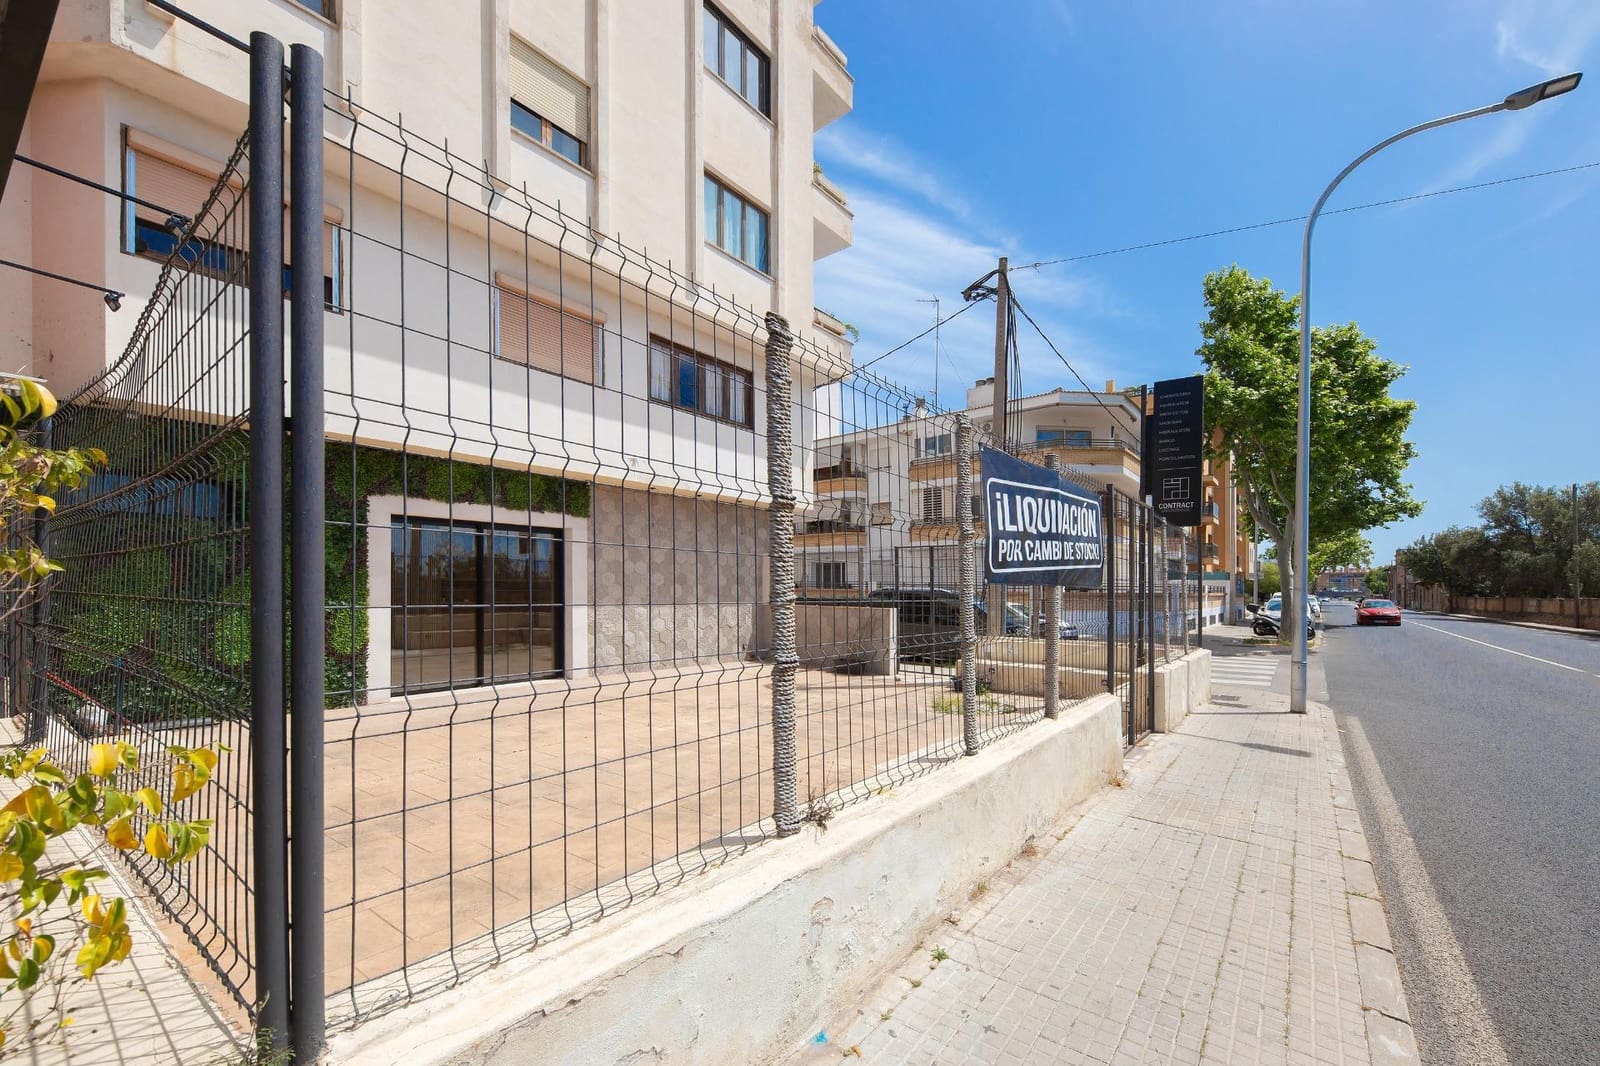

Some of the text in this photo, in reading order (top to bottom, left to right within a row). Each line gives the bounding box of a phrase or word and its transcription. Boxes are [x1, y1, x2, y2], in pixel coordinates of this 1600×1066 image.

[1158, 501, 1195, 510] CONTRACT
[998, 539, 1023, 562] POR
[1064, 541, 1075, 560] DE
[1075, 543, 1100, 561] STOCK!
